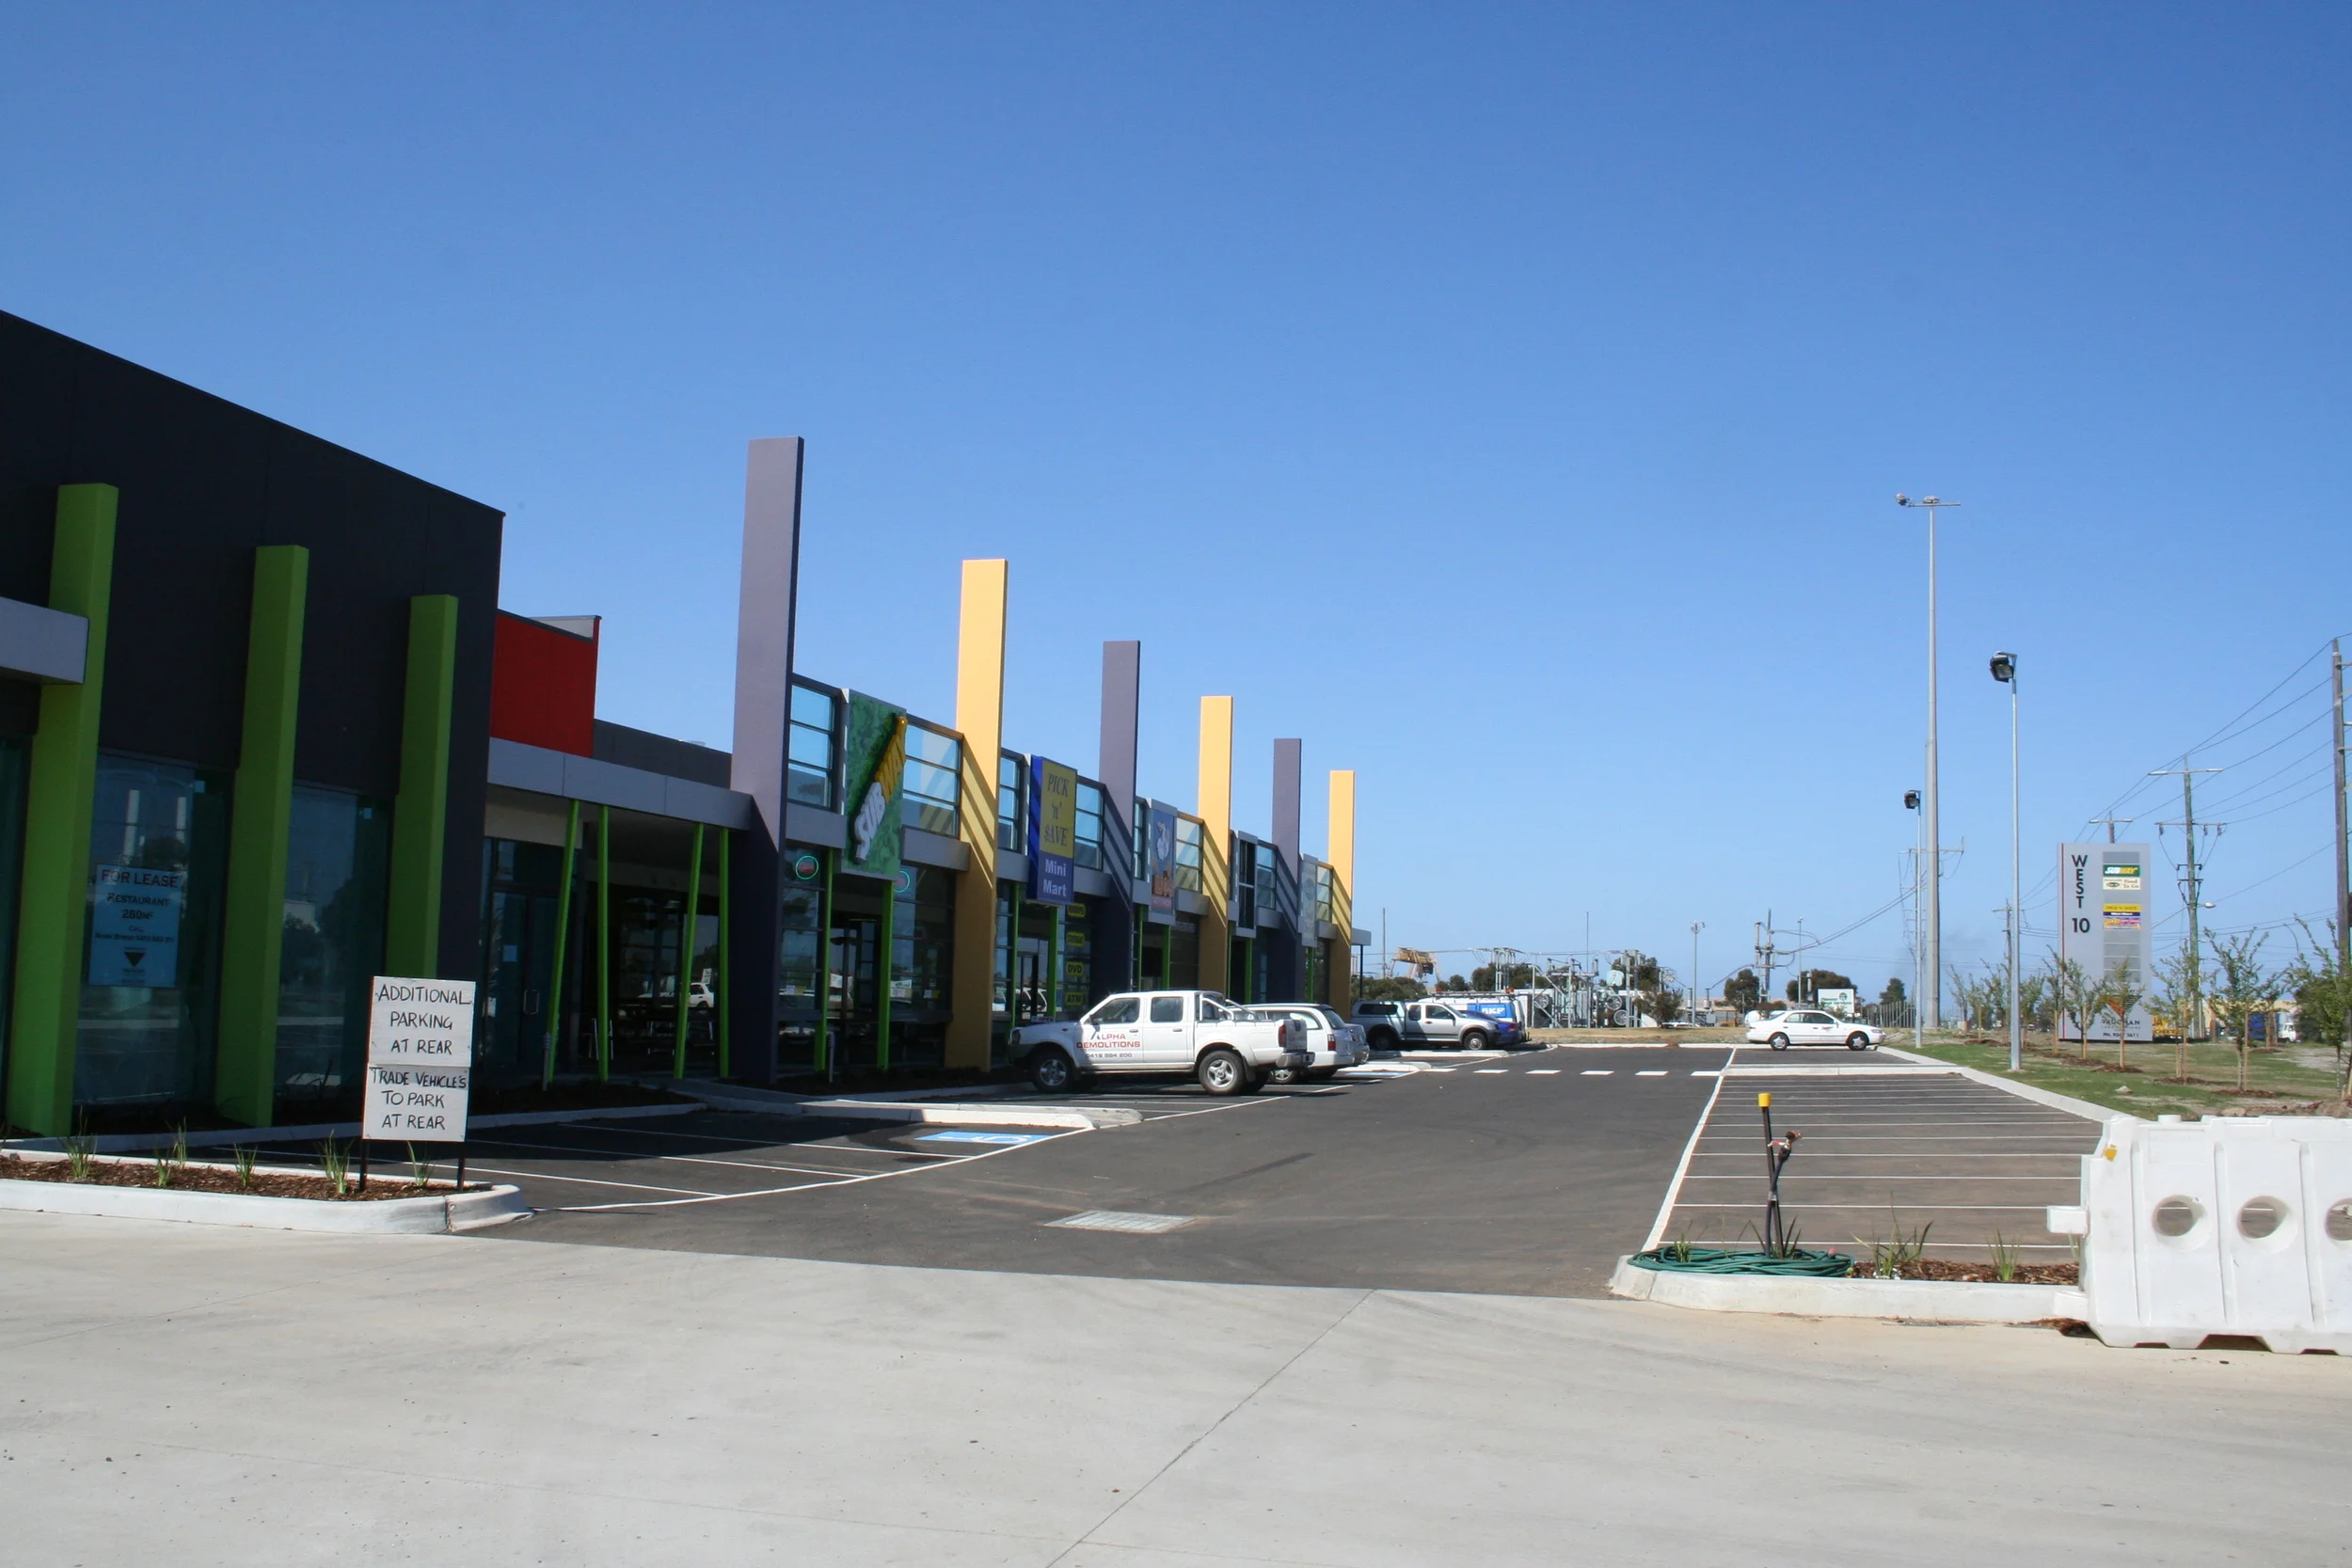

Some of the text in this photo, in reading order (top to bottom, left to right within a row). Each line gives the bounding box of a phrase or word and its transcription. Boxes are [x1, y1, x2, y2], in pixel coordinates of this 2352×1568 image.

[1047, 773, 1070, 798] PICK
[1045, 859, 1067, 877] Mini
[2105, 866, 2138, 875] SUBWAY
[102, 869, 179, 889] FOR LEASE
[1043, 879, 1067, 897] Mart
[107, 892, 169, 907] RESTAURANT
[2072, 855, 2090, 933] WEST 10
[378, 984, 472, 1005] ADDITIONAL
[389, 1011, 453, 1030] PARKING
[1090, 1031, 1126, 1040] ALPHA
[390, 1038, 453, 1054] AT REAR
[369, 1067, 467, 1088] TRADE VEHICLE'S
[381, 1090, 445, 1108] TO PARK
[381, 1114, 445, 1130] AT REAR
